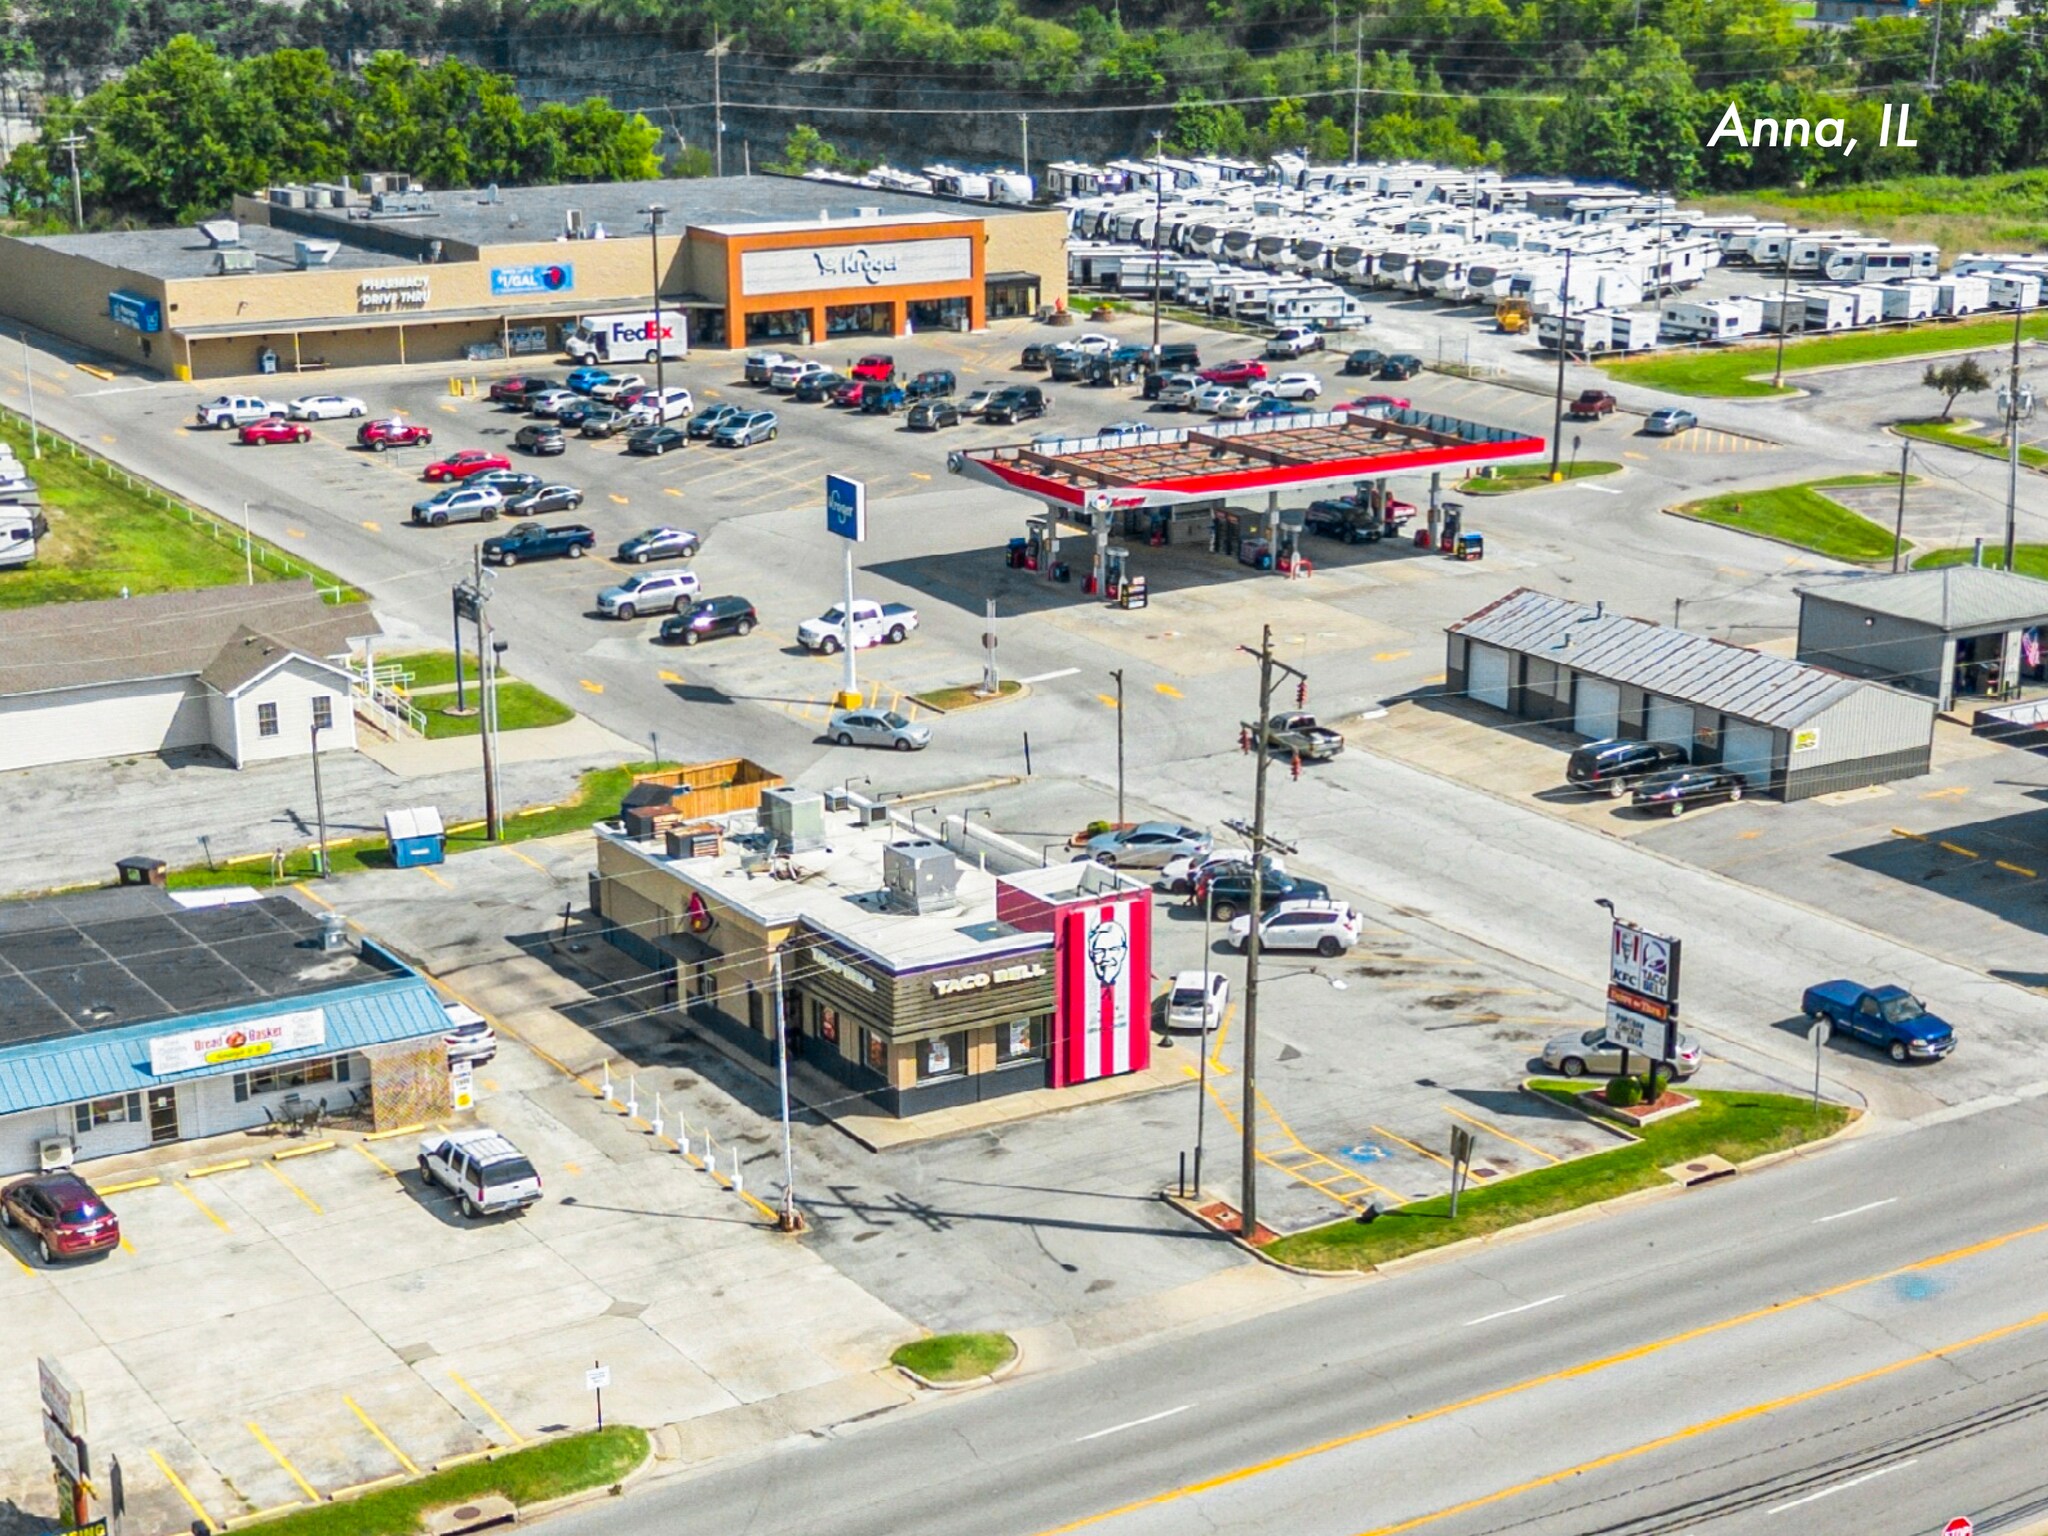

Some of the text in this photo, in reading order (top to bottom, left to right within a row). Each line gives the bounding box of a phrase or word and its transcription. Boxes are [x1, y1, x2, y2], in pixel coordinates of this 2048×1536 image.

[362, 275, 430, 291] PHARMACY
[362, 289, 430, 306] DRIVE THRU
[613, 320, 673, 342] FedEx
[932, 963, 1047, 996] TACO BELL
[1613, 968, 1637, 986] KFC
[1642, 968, 1667, 986] TACO
[1643, 979, 1666, 997] BELL
